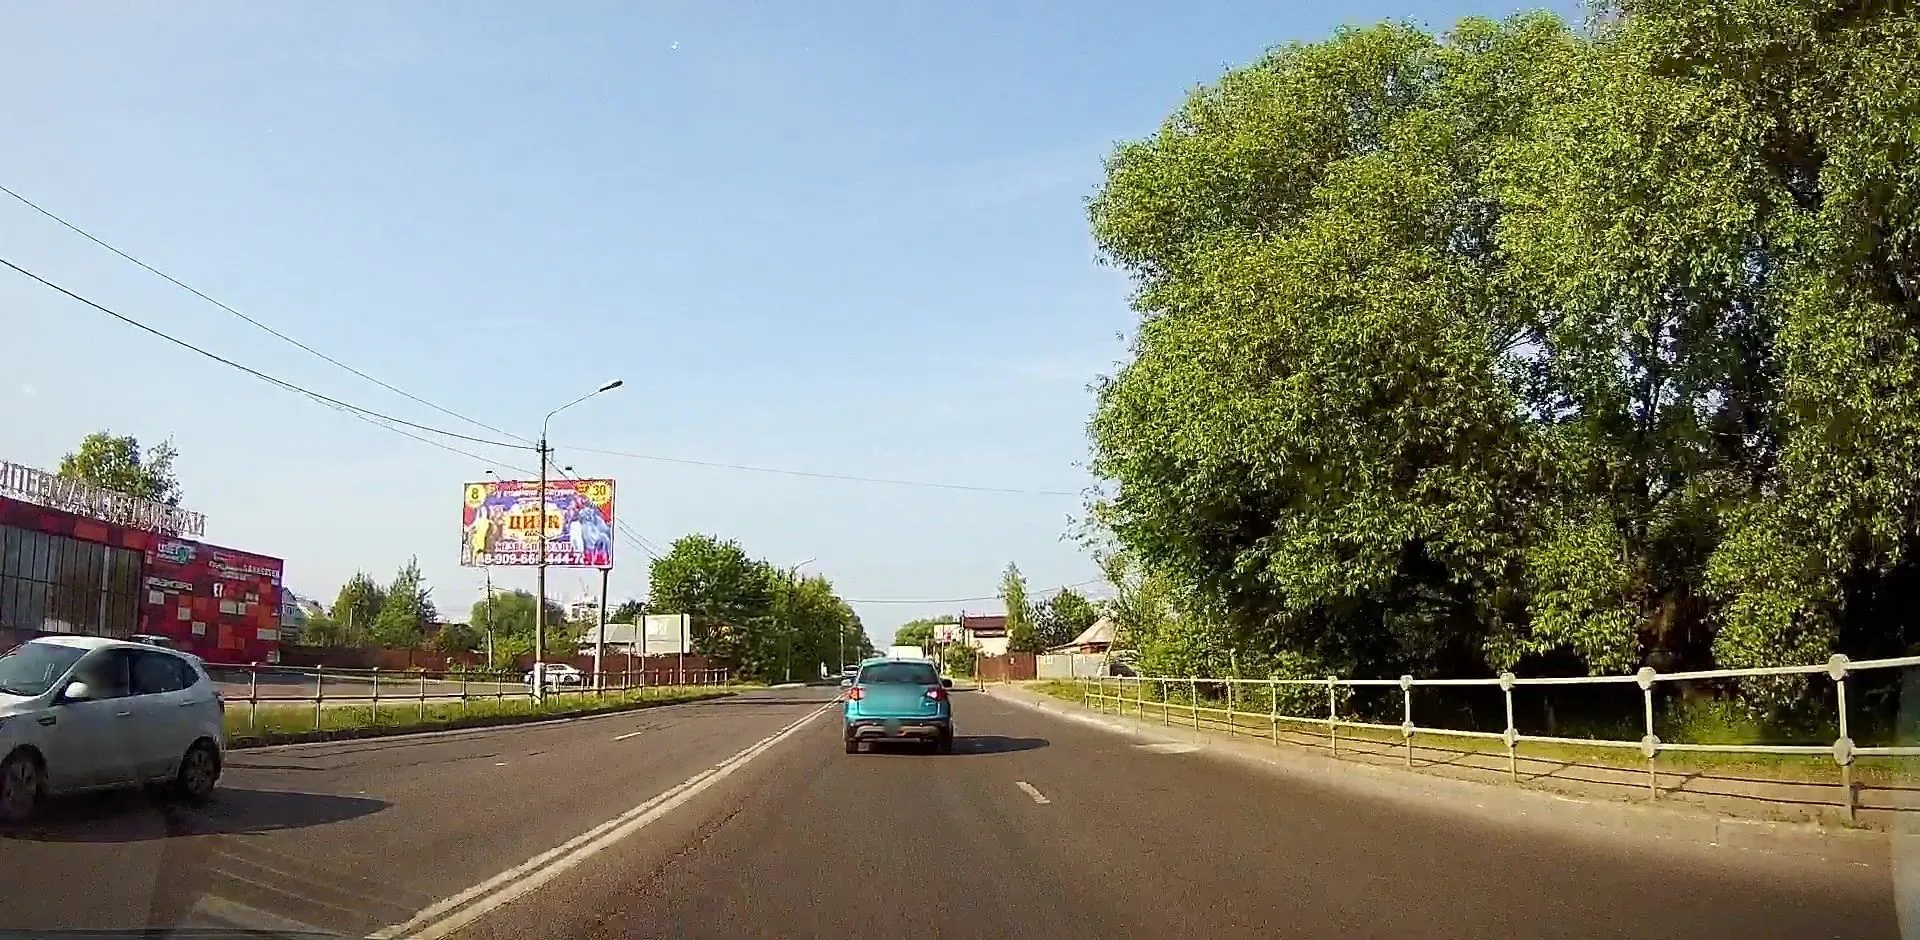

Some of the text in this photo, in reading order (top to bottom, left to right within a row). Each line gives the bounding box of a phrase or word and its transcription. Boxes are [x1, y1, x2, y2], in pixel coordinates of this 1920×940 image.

[471, 487, 479, 500] 8
[593, 485, 606, 496] 30
[508, 515, 561, 531] ЦИК
